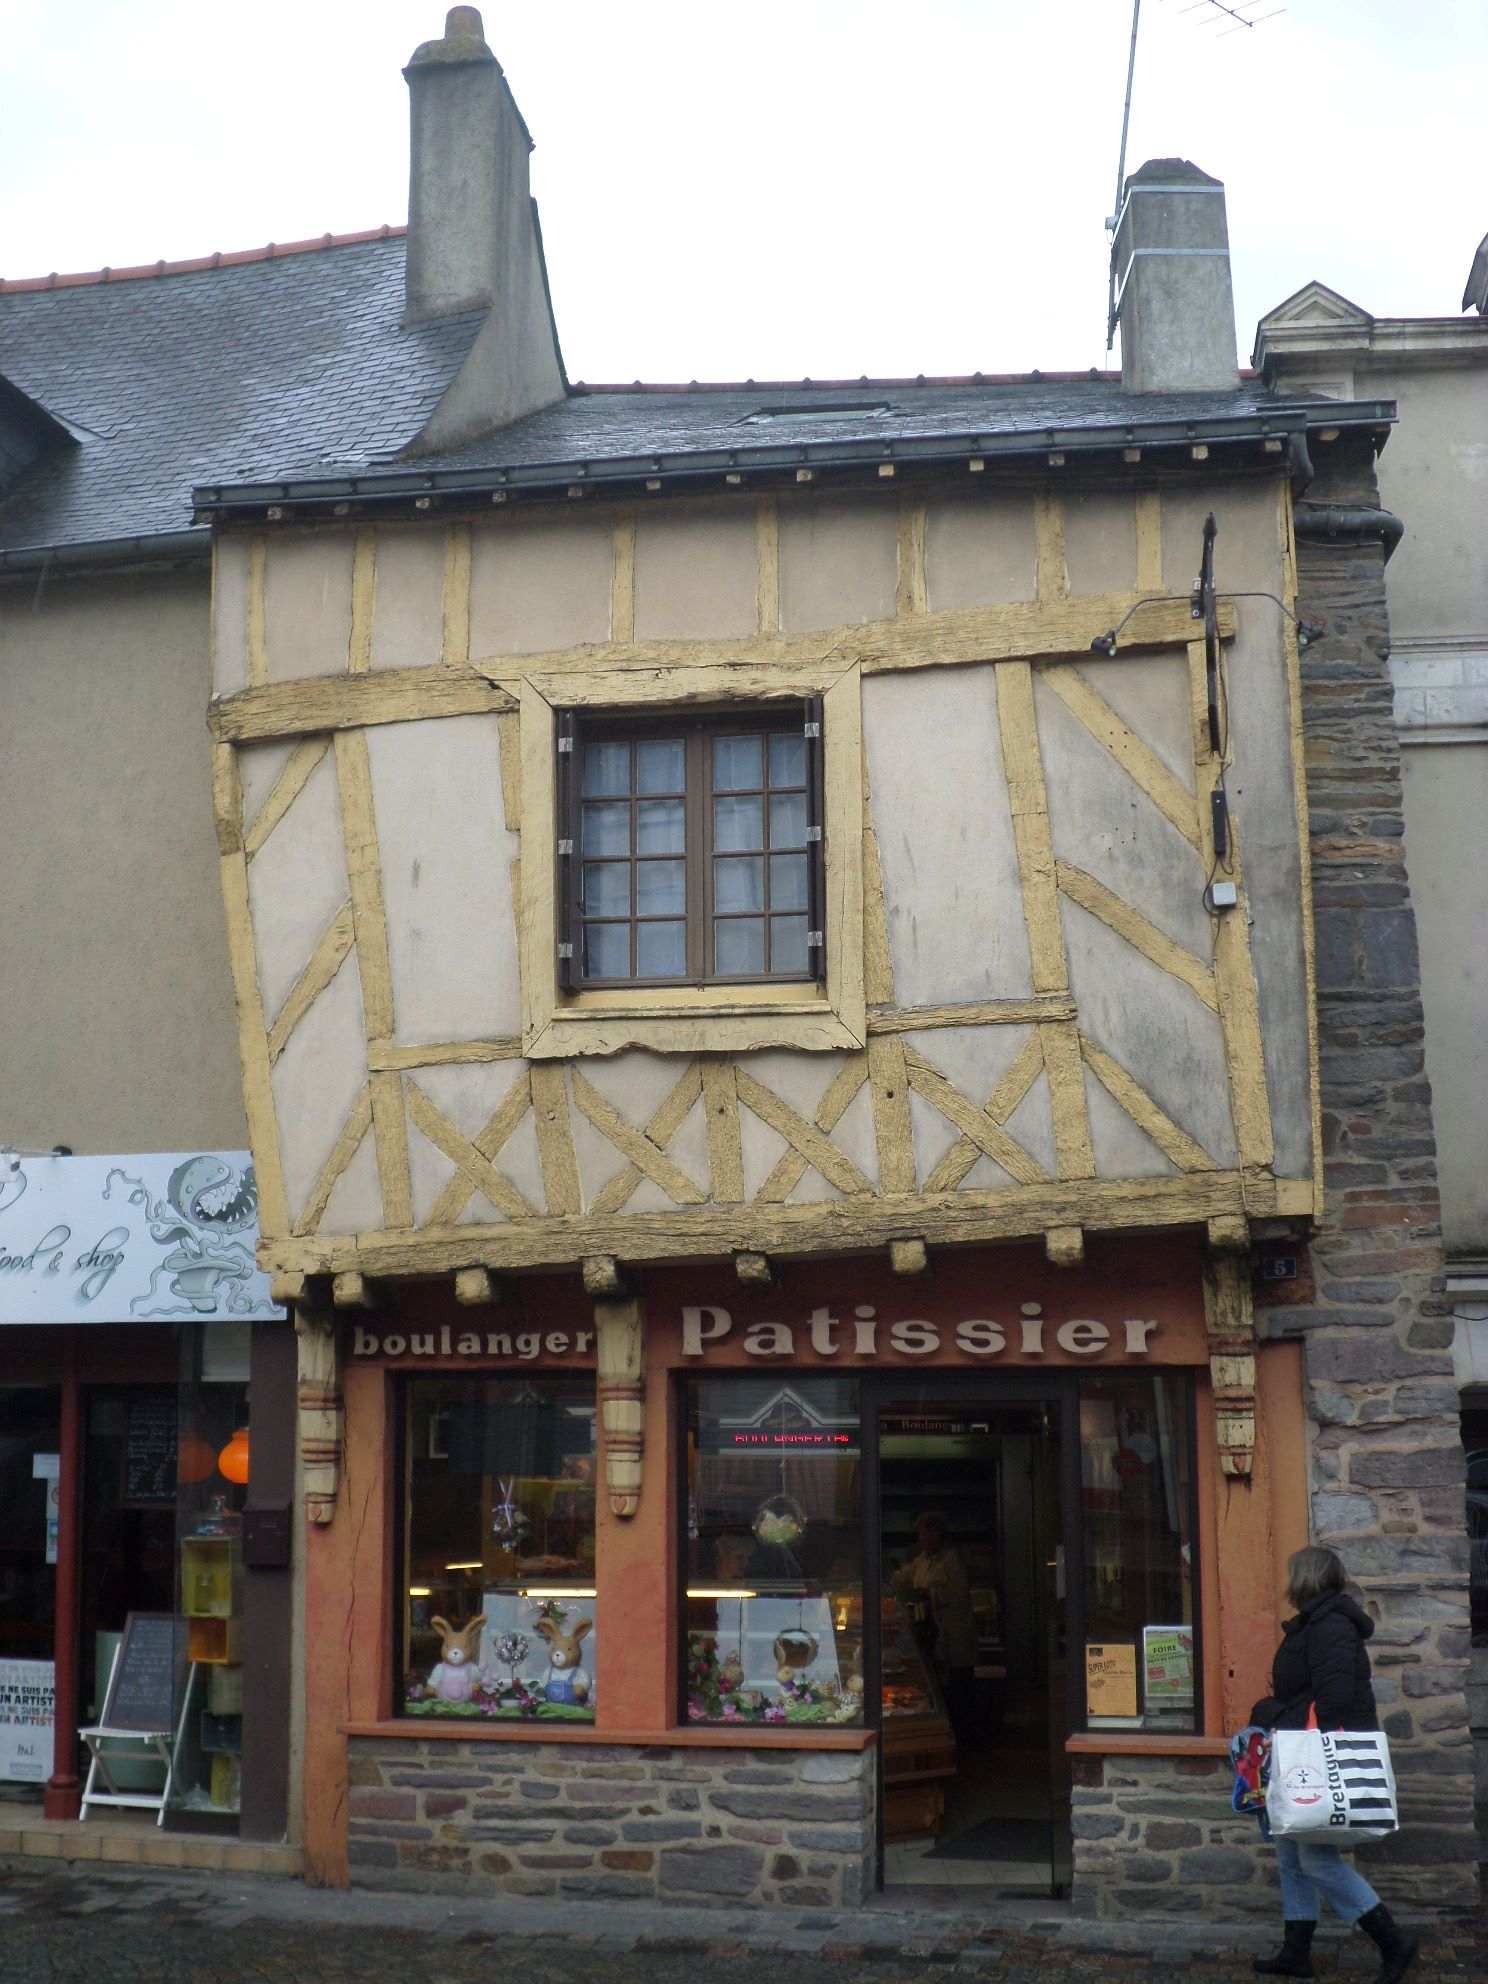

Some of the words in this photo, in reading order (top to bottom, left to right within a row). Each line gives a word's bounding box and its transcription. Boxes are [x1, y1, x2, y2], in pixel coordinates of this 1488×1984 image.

[0, 1225, 71, 1271] ood
[49, 1252, 63, 1272] &
[76, 1227, 130, 1300] shop
[1273, 1260, 1287, 1276] 5
[680, 1302, 1159, 1356] Patissier
[352, 1325, 597, 1359] boulanger
[1153, 1645, 1177, 1654] FOIRE
[1088, 1662, 1104, 1674] SUPER
[1103, 1659, 1117, 1670] LOTO
[0, 1685, 6, 1693] E
[8, 1685, 20, 1694] NE
[21, 1686, 41, 1695] SUIS
[43, 1687, 56, 1696] PA
[15, 1695, 54, 1707] ARTIST
[14, 1715, 54, 1727] ARTIST
[1321, 1736, 1347, 1826] Bretagne
